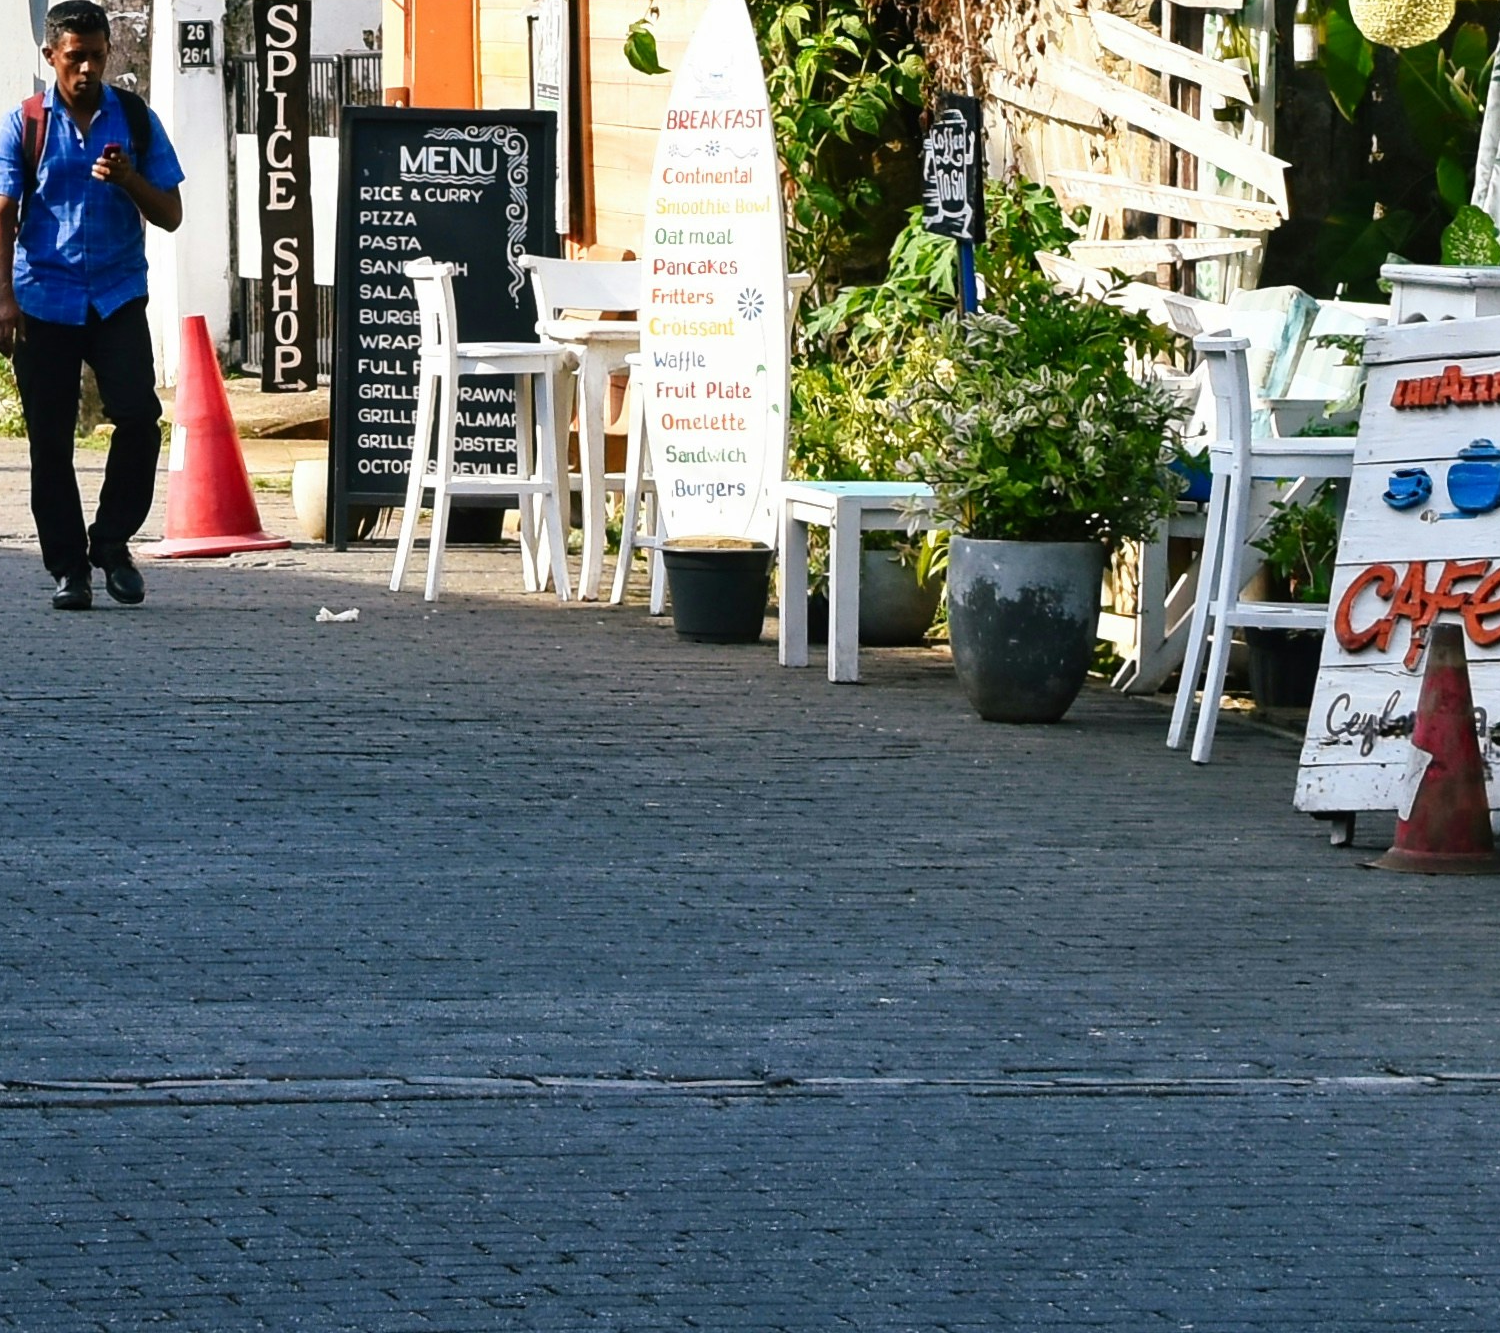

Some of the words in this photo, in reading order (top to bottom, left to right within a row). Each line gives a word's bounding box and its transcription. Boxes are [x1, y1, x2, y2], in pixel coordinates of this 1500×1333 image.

[187, 24, 205, 41] 26
[182, 47, 211, 64] 26/1
[265, 3, 299, 211] SPICE
[666, 109, 766, 130] BREAKFAST
[932, 127, 965, 159] Coffee
[400, 145, 498, 175] MENU
[662, 167, 753, 184] Continental
[360, 186, 403, 201] RICE
[410, 188, 421, 202] &
[424, 188, 483, 204] CURRY
[656, 197, 731, 214] Smoothie
[735, 196, 771, 213] Bowl
[359, 211, 418, 226] PIZZA
[359, 235, 422, 251] PASTA
[655, 227, 684, 245] Oat
[689, 228, 734, 245] meal
[653, 258, 738, 275] Pancakes
[359, 284, 418, 300] SALA
[652, 288, 715, 305] Fritters
[271, 237, 302, 383] SHOP
[359, 308, 421, 325] BURGE
[648, 317, 736, 336] Croissant
[359, 334, 422, 350] WRAP
[358, 359, 407, 375] FULL
[653, 351, 707, 372] Waffle
[656, 382, 697, 399] Fruit
[706, 382, 752, 399] Plate
[358, 408, 418, 424] GRILLE
[661, 413, 747, 431] Omelette
[357, 433, 415, 449] GRILLE
[454, 437, 517, 453] OBSTER
[666, 445, 747, 464] Sandwich
[358, 459, 438, 475] OCTOPS
[451, 462, 518, 476] DEVILLE
[674, 479, 746, 503] Burgers
